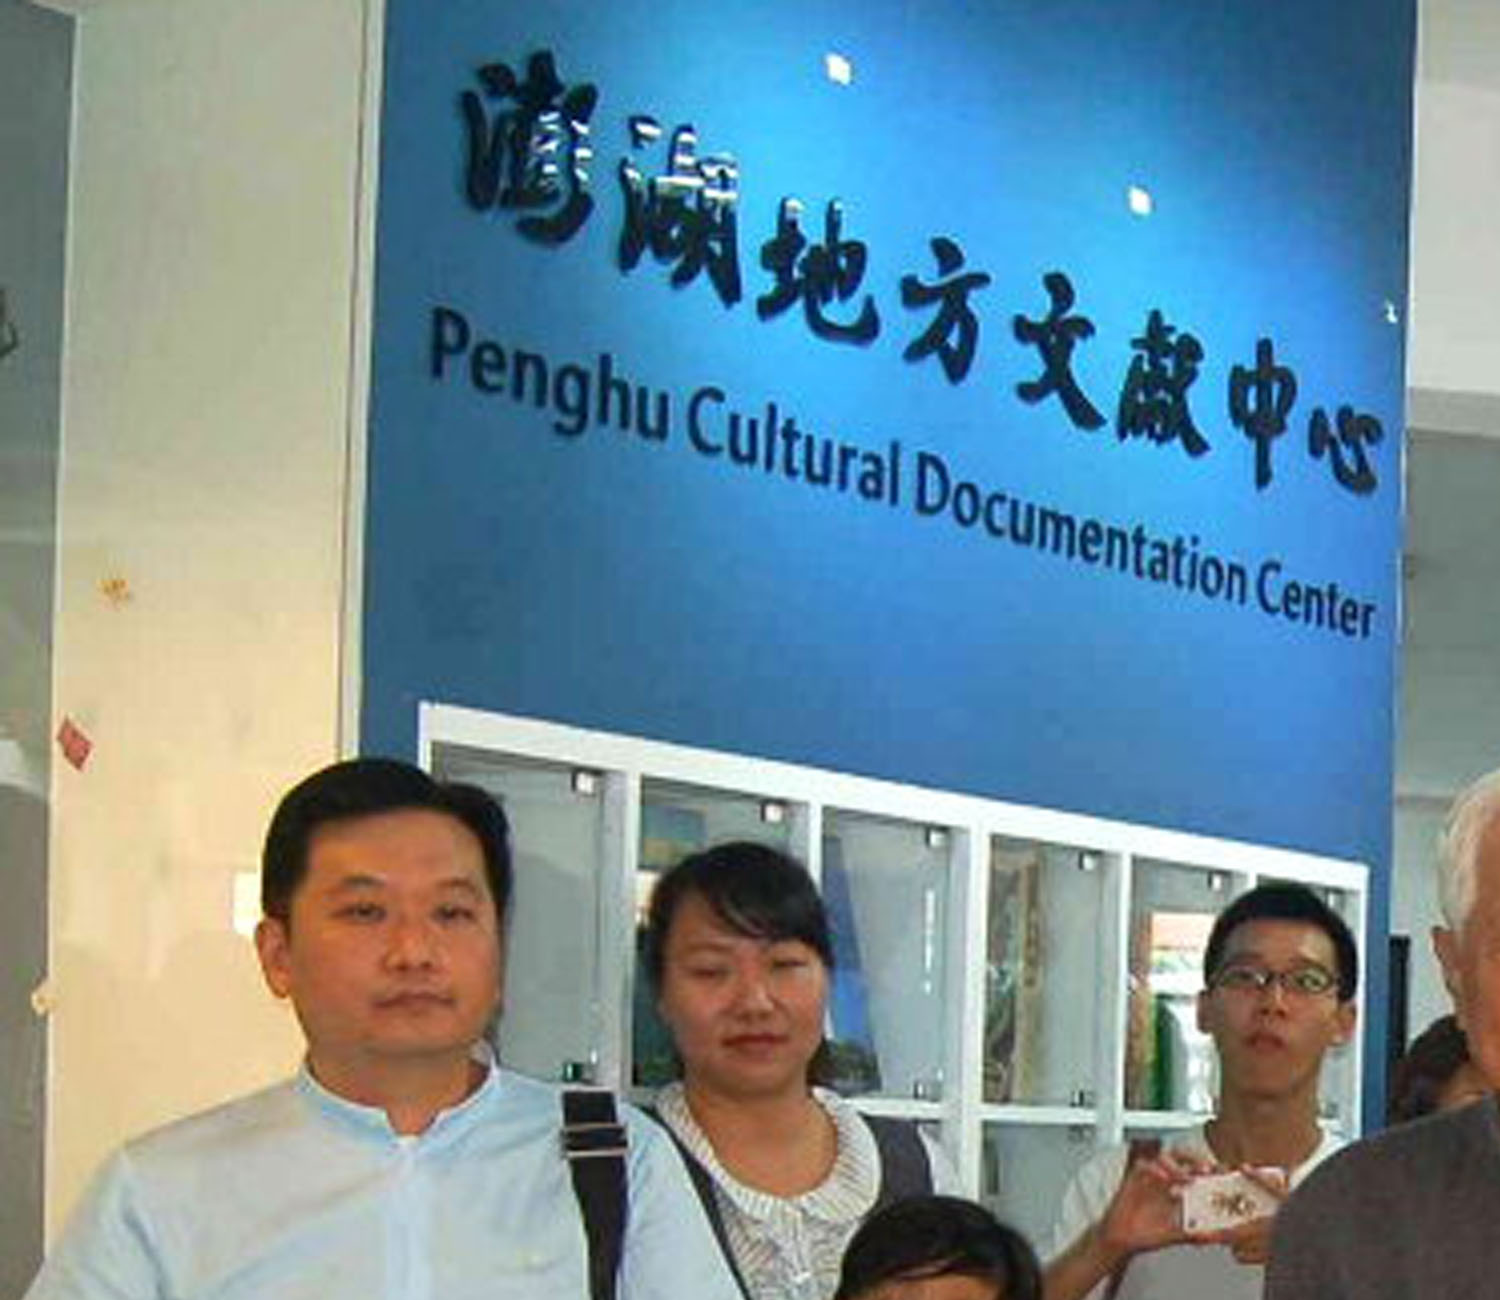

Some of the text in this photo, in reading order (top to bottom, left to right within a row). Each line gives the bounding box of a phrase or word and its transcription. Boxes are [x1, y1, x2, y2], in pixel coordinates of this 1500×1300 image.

[458, 50, 1384, 494] 澎湖地方文獻中心
[430, 306, 1376, 640] Penghu Cultural Documentation Center
